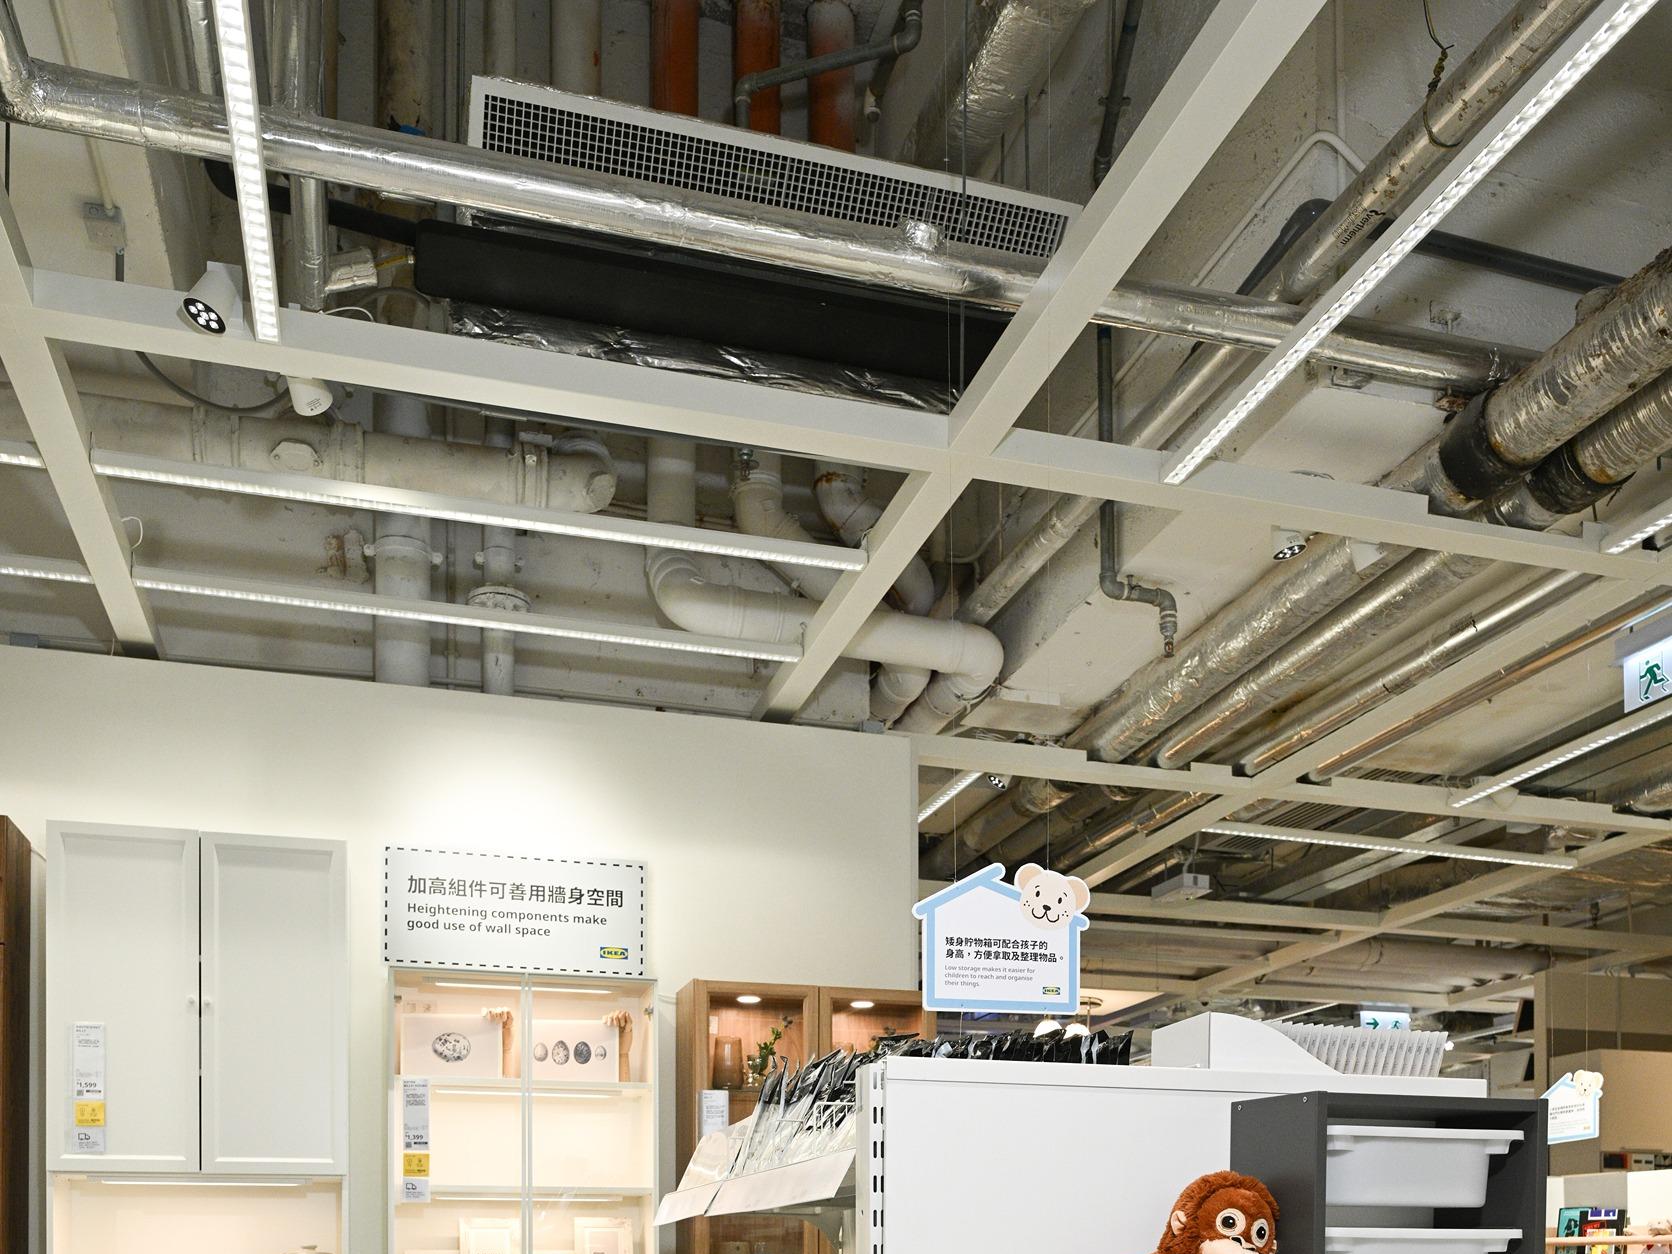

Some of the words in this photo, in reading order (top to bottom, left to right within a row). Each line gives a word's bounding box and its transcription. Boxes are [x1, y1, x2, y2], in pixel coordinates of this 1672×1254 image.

[407, 875, 624, 908] 加高組件可善用牆身空間
[407, 902, 488, 920] Heightening
[491, 908, 569, 924] components
[573, 913, 607, 925] make
[407, 918, 439, 931] good
[443, 922, 466, 932] use
[469, 922, 482, 932] of
[485, 924, 511, 934] wall
[515, 926, 551, 938] space
[945, 936, 1048, 951] 矮身貯物箱可配合孩子的
[601, 948, 627, 958] IKEA
[958, 965, 981, 973] storage
